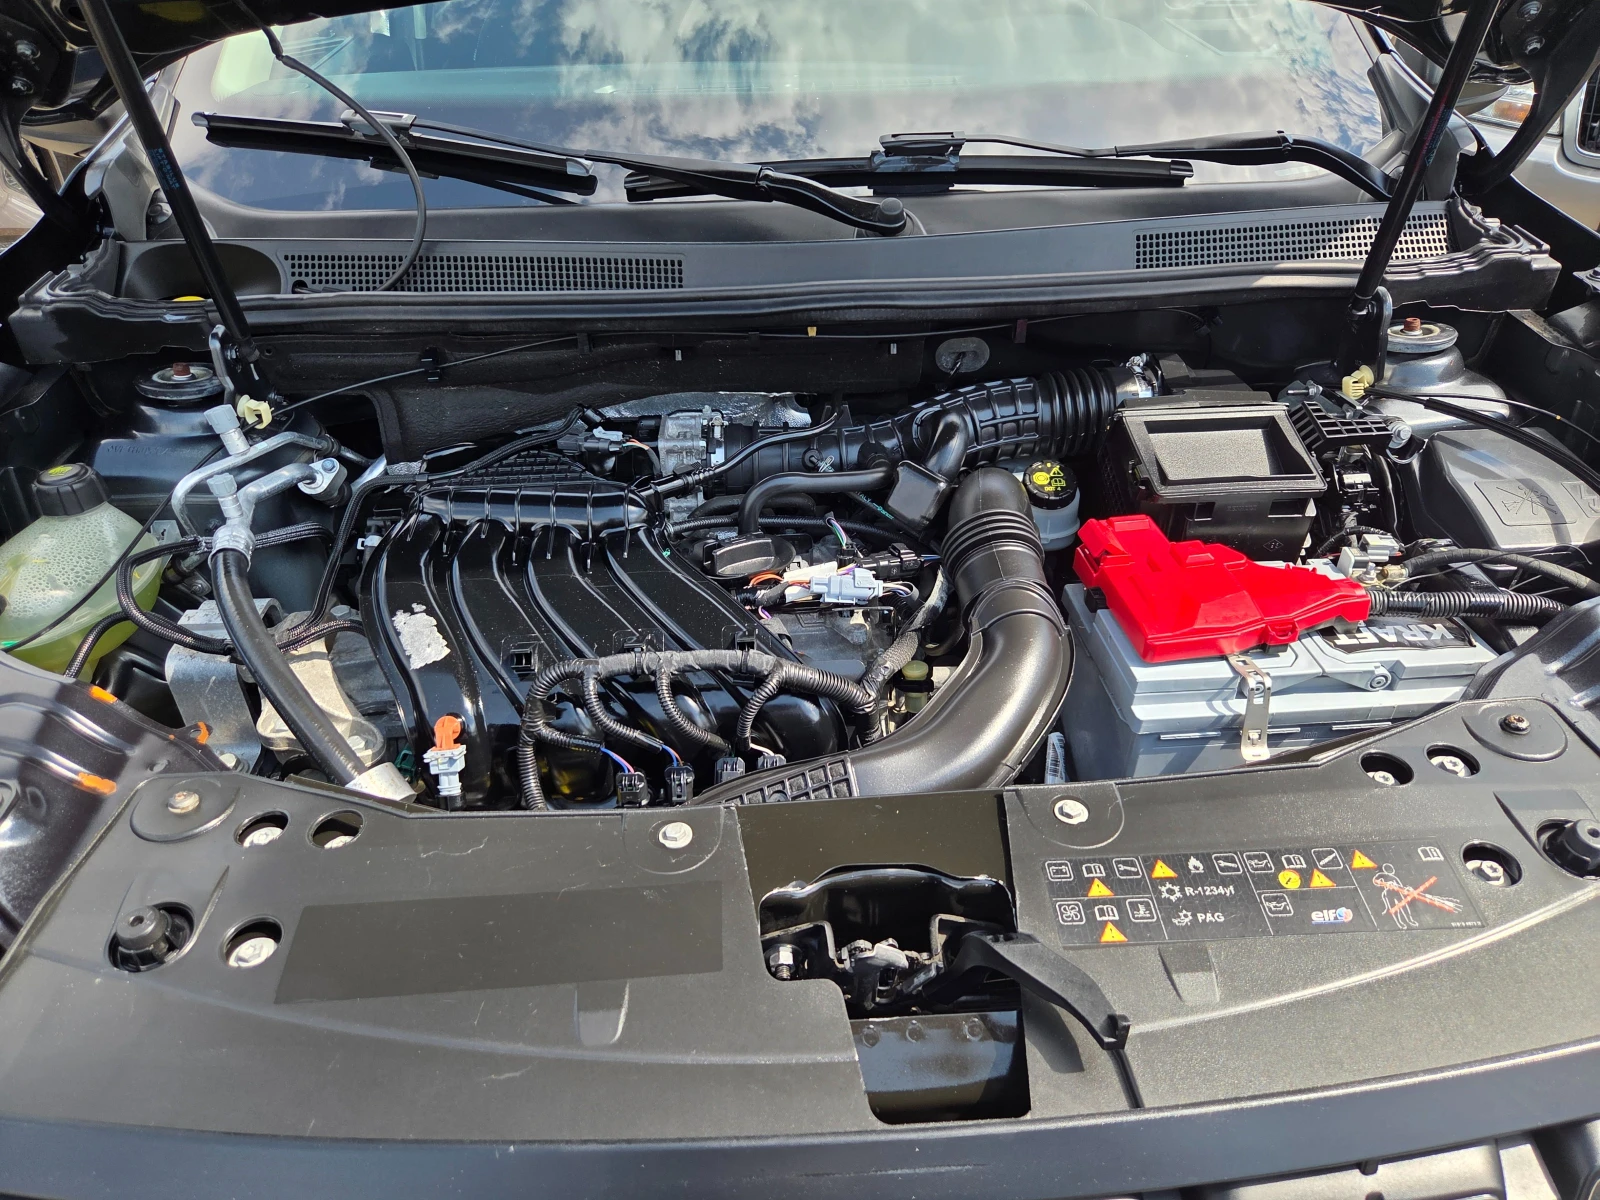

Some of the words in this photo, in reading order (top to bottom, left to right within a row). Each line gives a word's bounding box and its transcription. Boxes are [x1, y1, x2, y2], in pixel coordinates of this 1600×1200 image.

[1334, 623, 1454, 645] KRAFT
[1185, 885, 1235, 897] R-1234yf
[1197, 911, 1225, 923] PAG
[1311, 909, 1336, 921] elf
